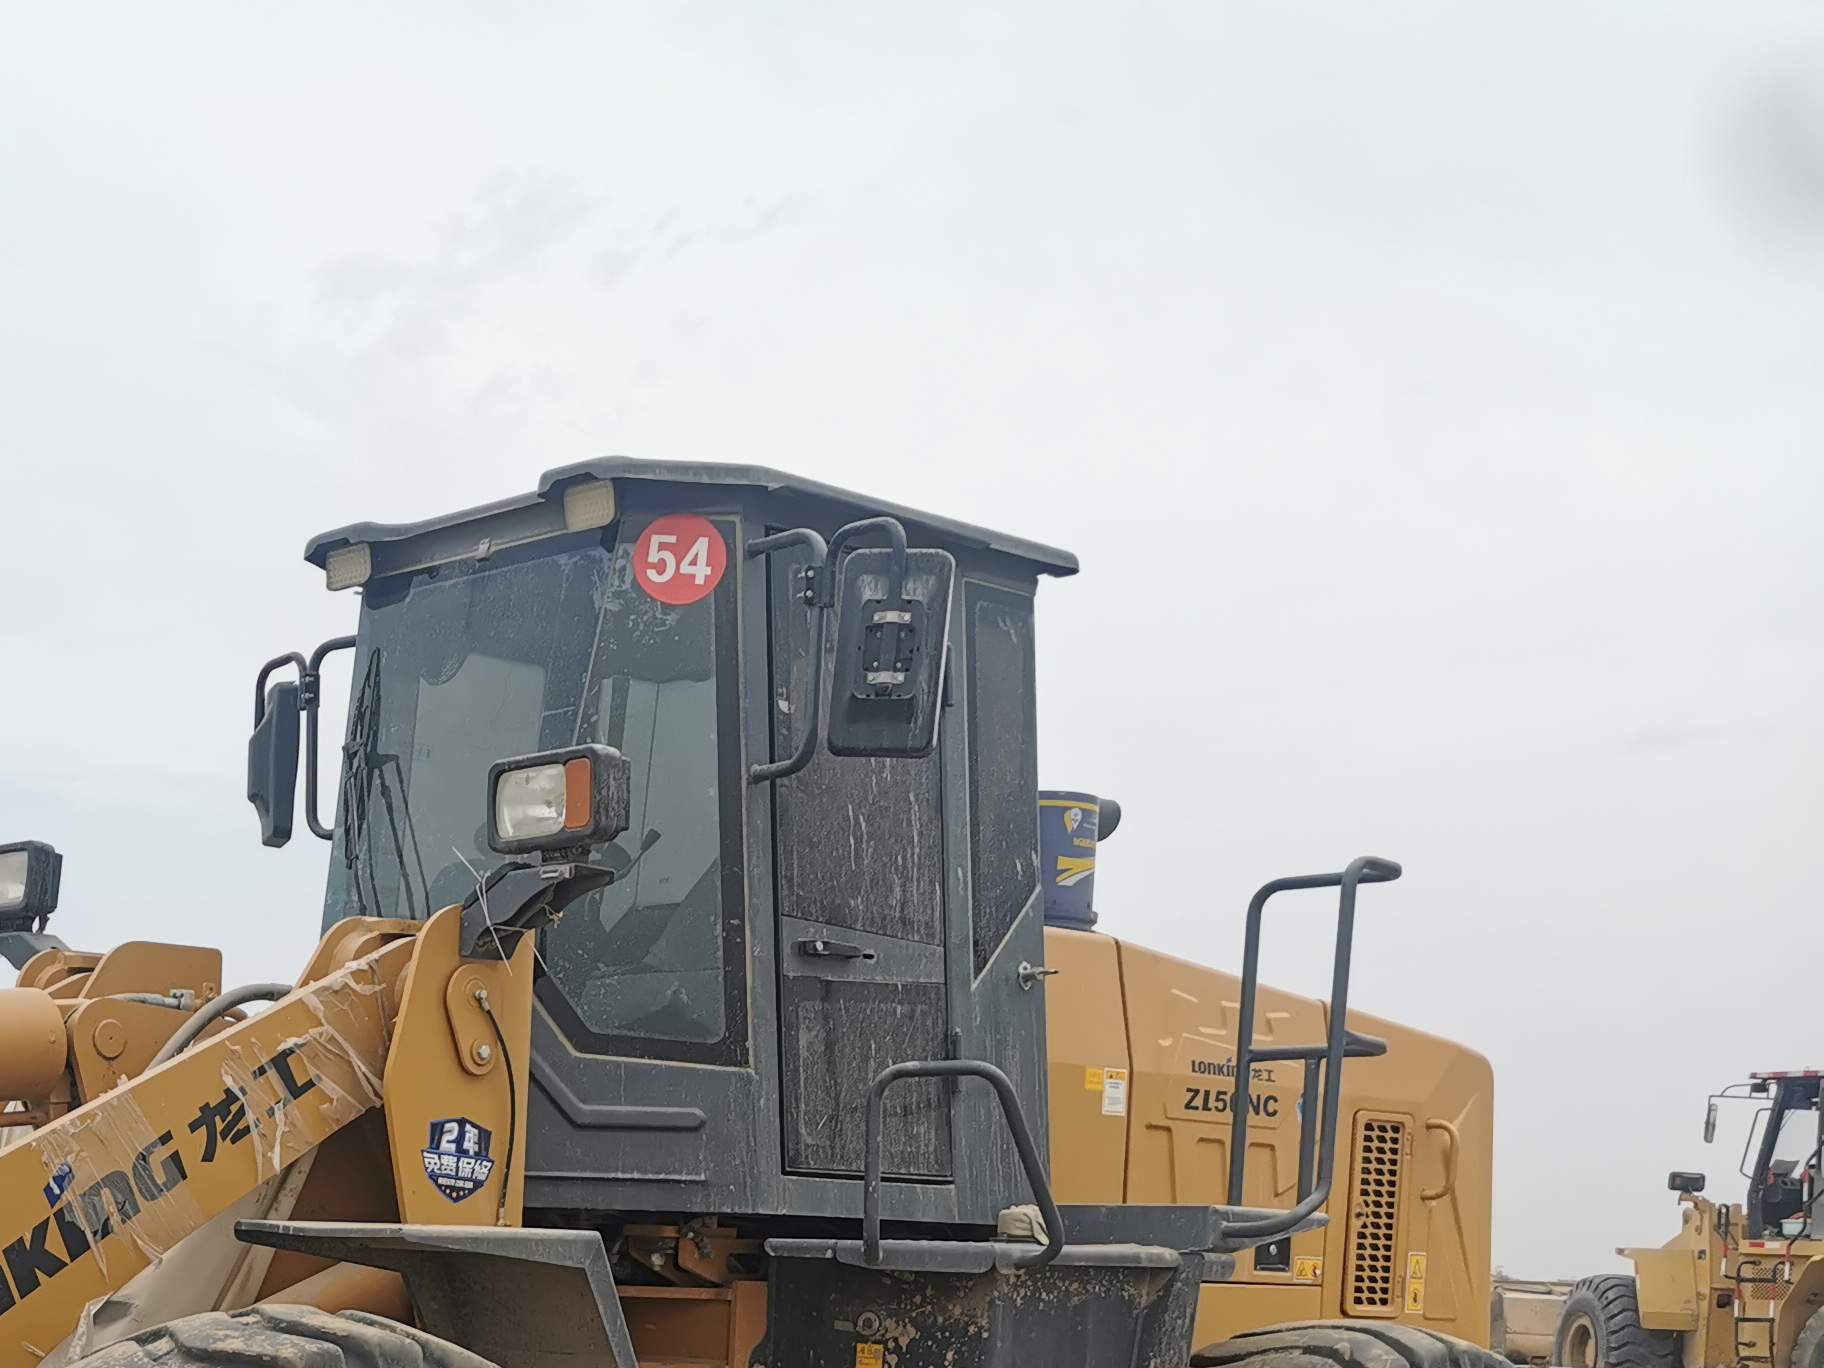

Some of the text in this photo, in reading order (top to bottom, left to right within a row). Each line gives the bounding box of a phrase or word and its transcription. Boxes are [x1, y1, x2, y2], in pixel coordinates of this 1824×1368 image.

[645, 534, 713, 586] 54
[422, 1152, 493, 1181] 免费保修
